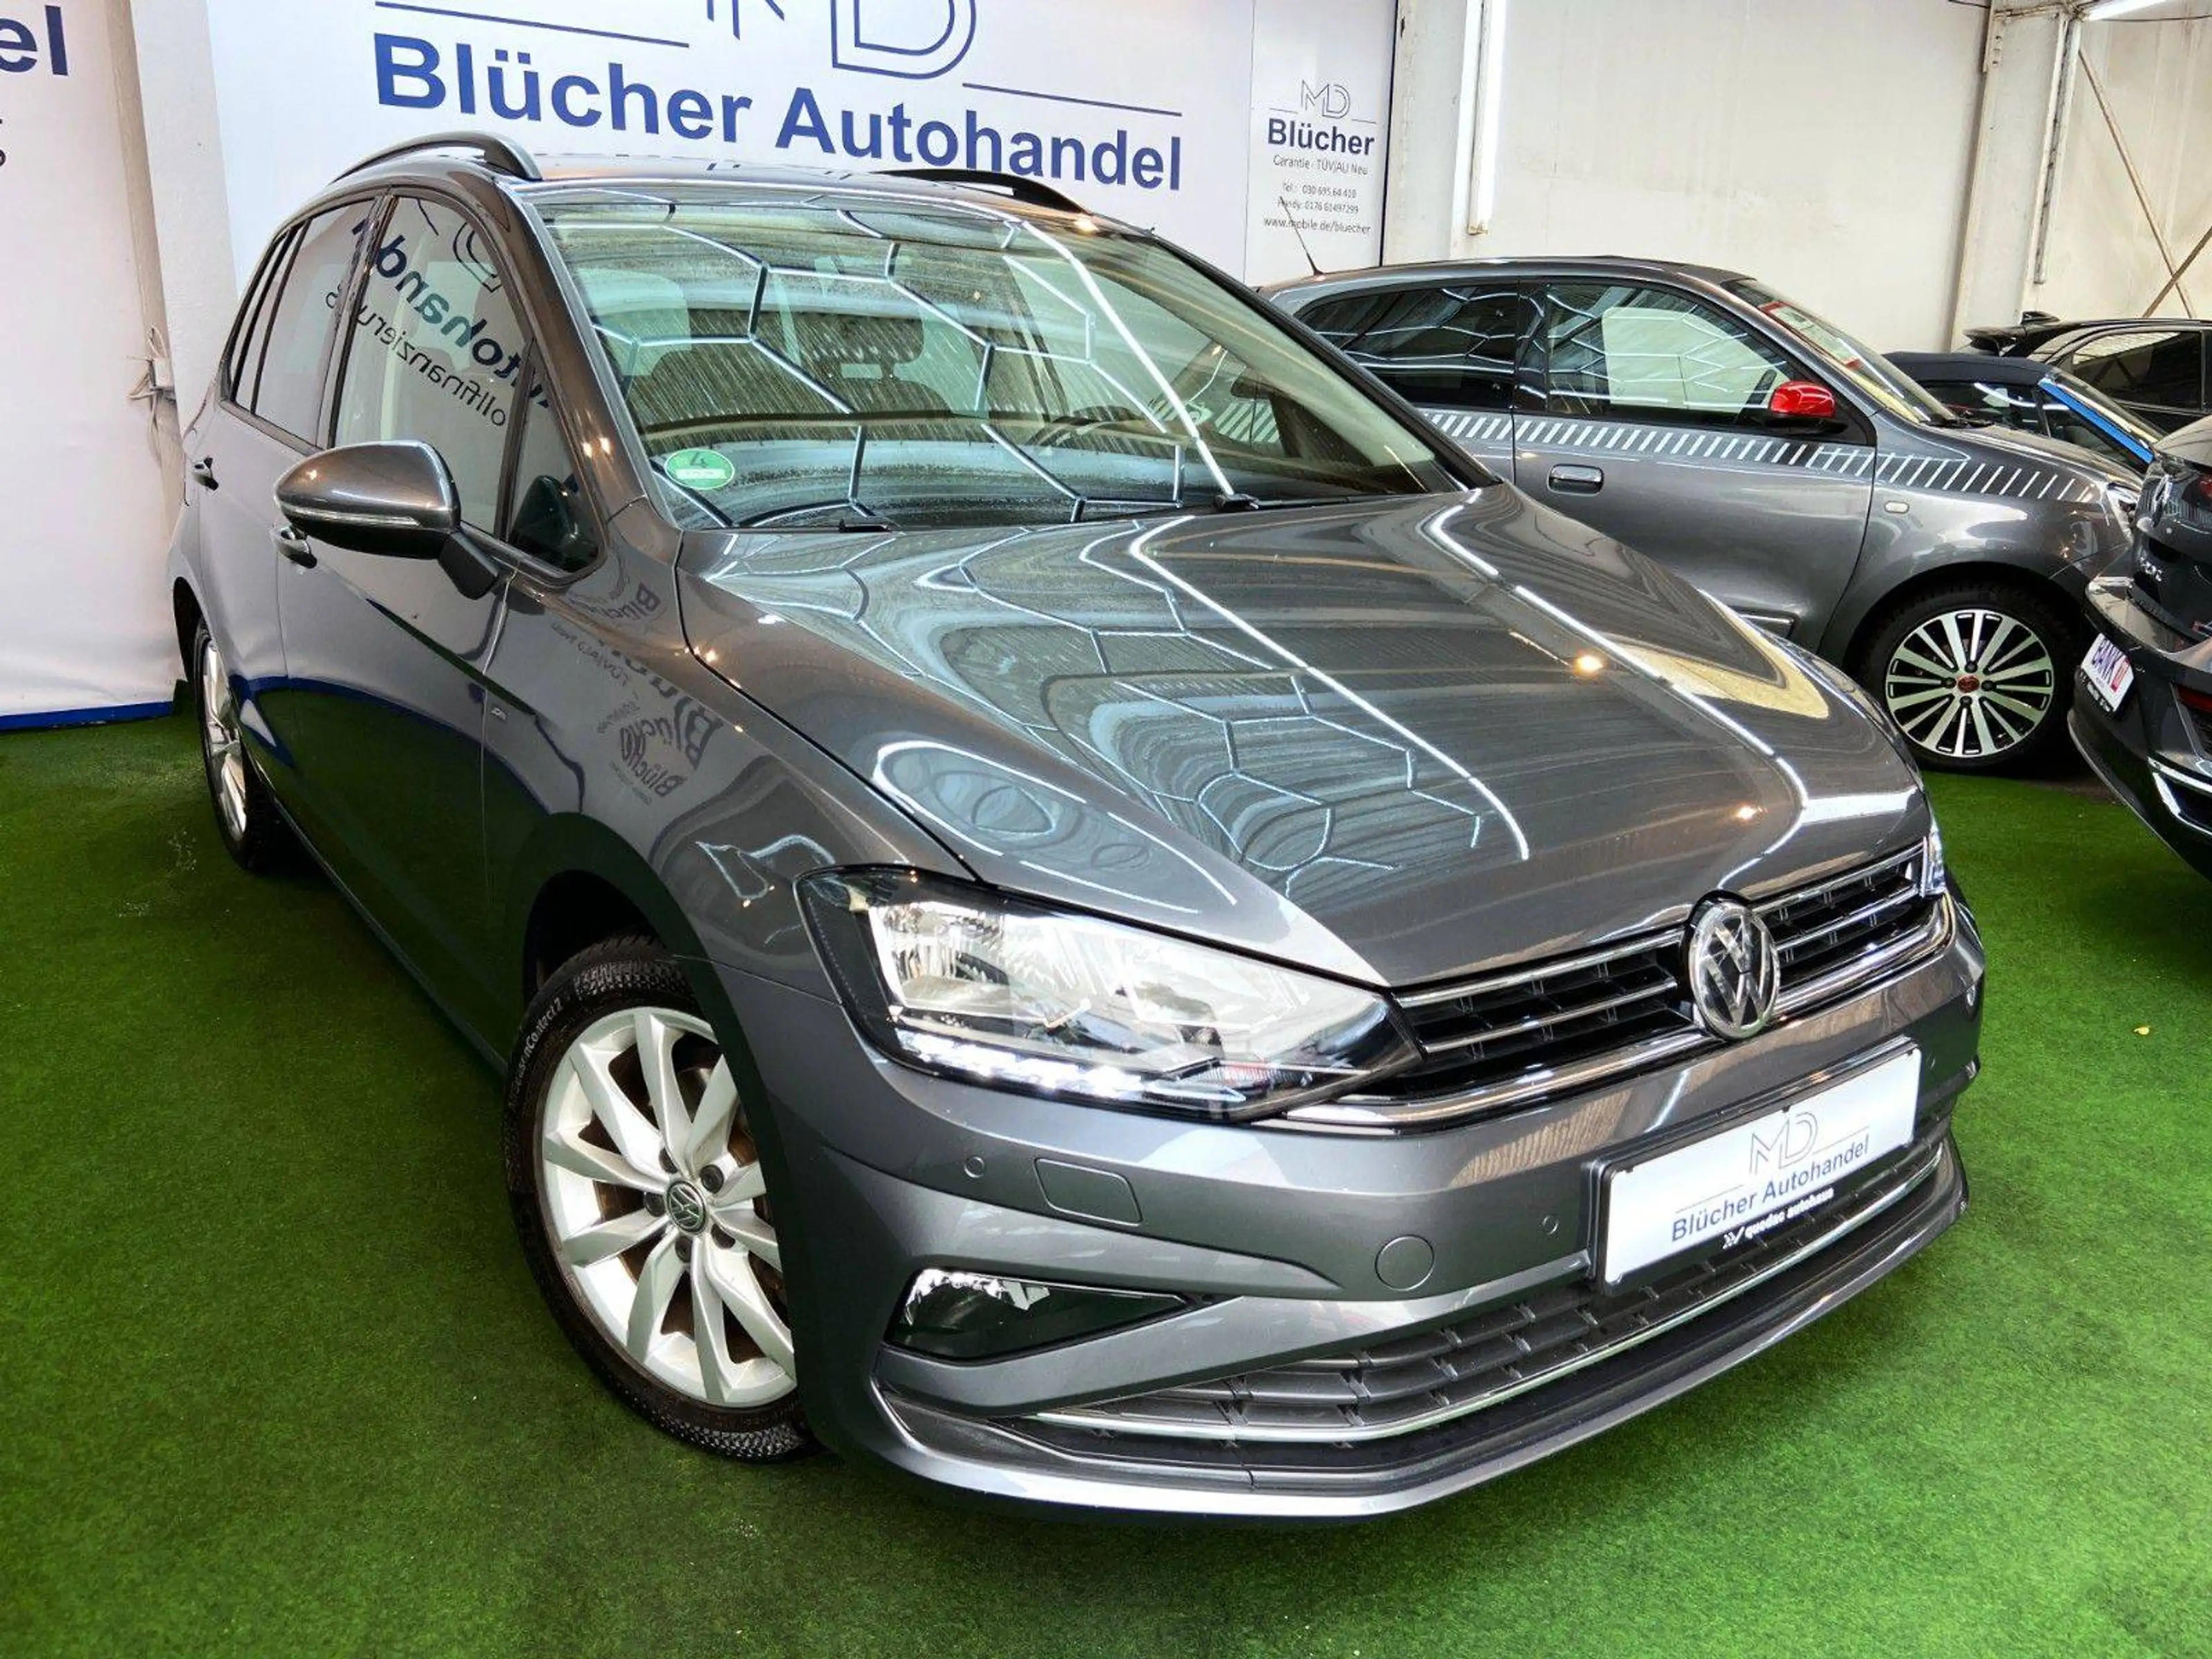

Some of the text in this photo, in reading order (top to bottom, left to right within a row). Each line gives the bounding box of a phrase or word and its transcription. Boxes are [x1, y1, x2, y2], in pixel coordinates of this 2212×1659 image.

[374, 33, 753, 143] Blücher
[775, 87, 1180, 190] Autohandel
[1268, 118, 1374, 155] Blücher
[1672, 1191, 1758, 1242] Blücher
[1763, 1134, 1869, 1203] Autohandel
